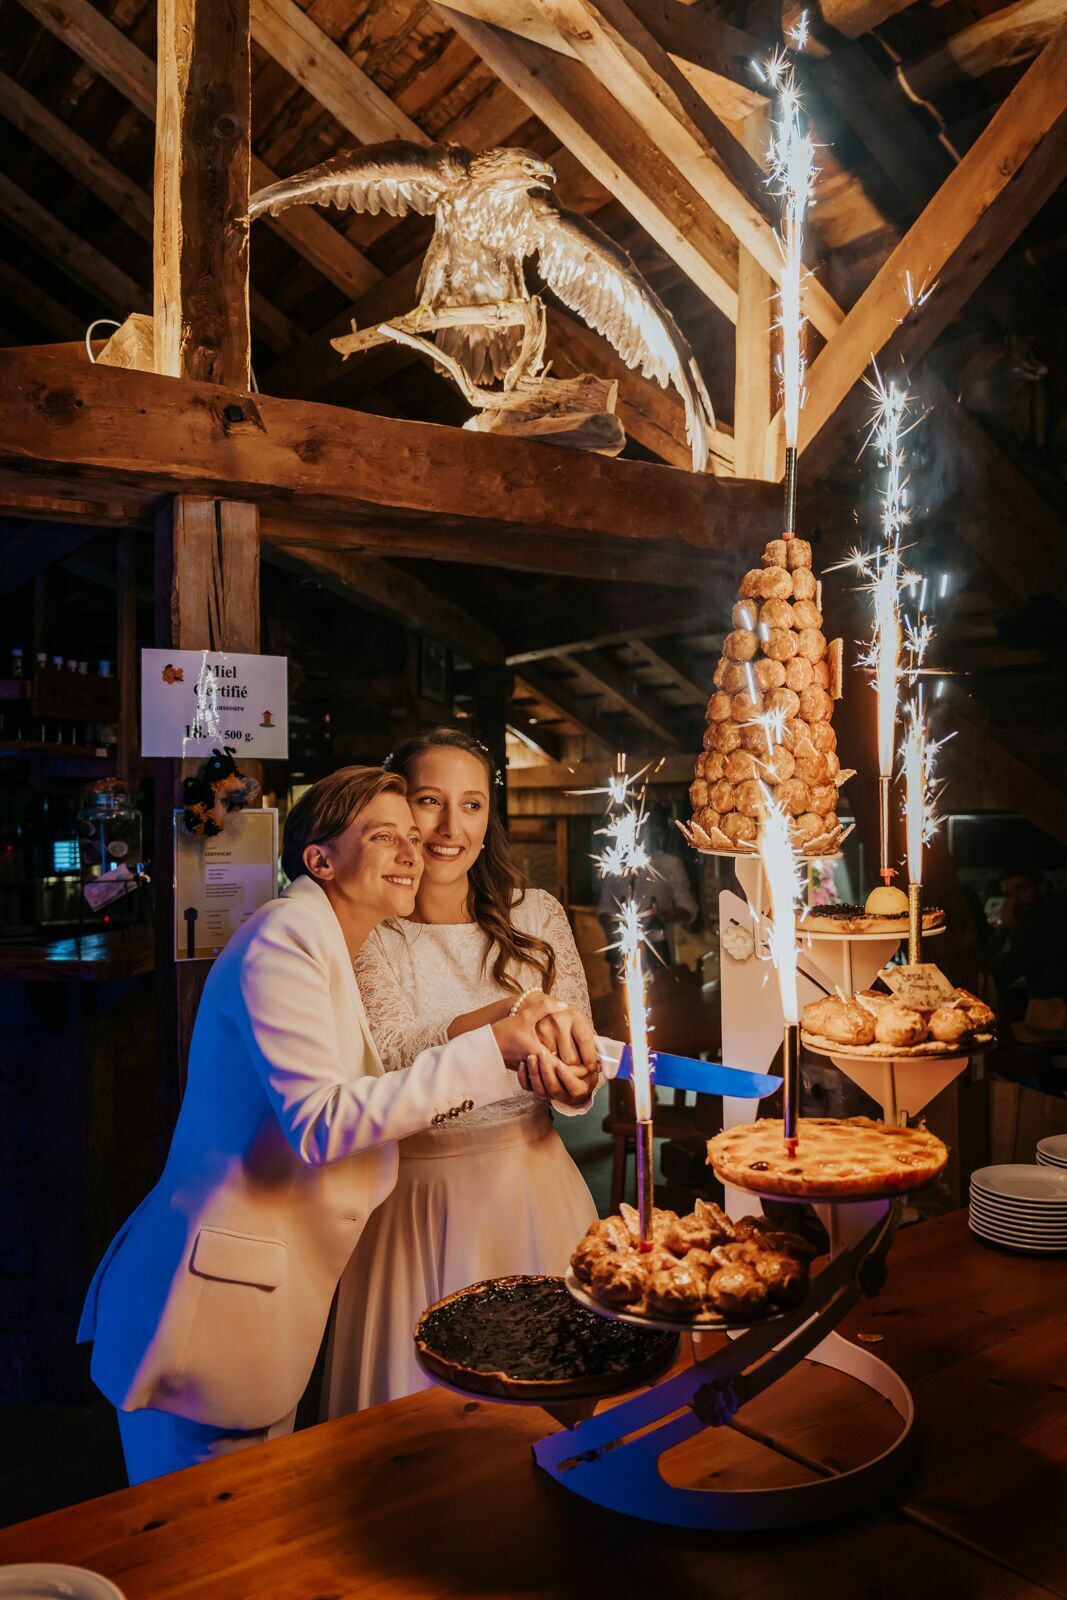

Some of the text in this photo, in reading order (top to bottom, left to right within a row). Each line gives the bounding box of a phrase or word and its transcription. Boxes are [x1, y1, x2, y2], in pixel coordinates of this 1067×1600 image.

[206, 664, 237, 679] Miel
[193, 683, 248, 699] Cetifié
[224, 730, 242, 740] 500
[244, 732, 254, 743] g.
